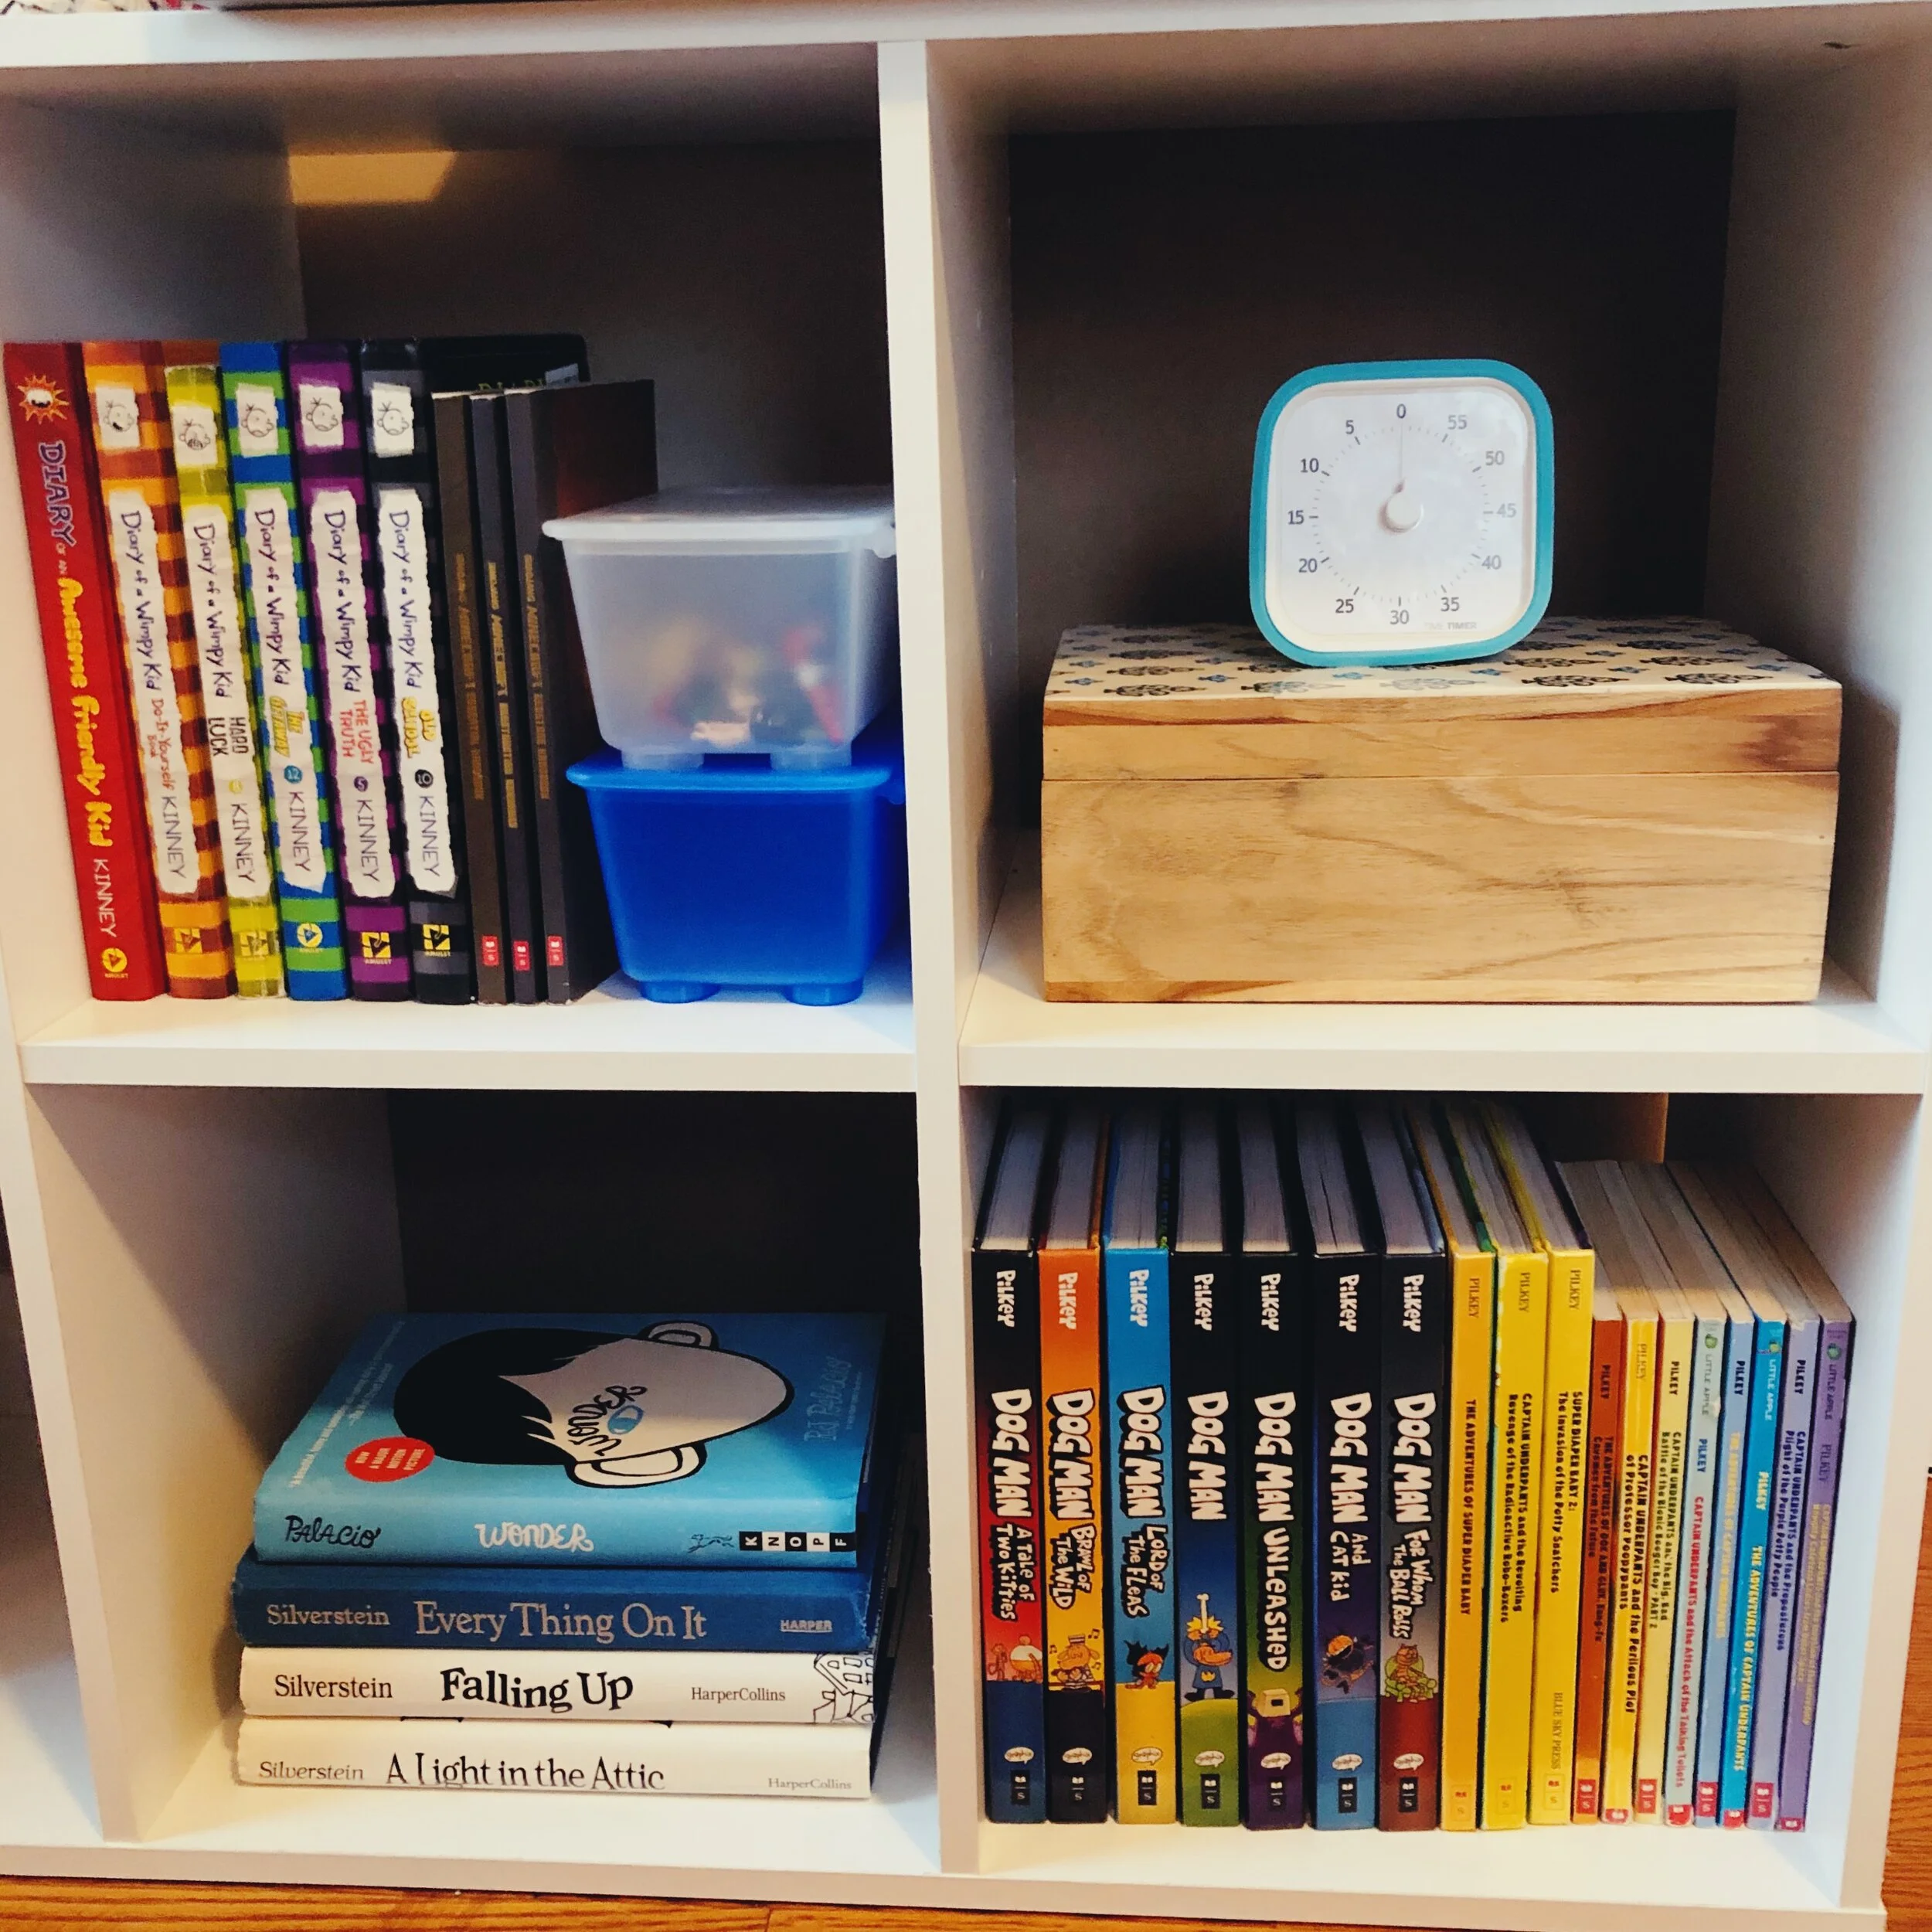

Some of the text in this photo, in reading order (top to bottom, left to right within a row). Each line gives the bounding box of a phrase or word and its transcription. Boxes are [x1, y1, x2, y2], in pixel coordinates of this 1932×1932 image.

[1345, 420, 1355, 434] 5
[1396, 403, 1406, 419] 0
[1447, 415, 1468, 430] 55
[1300, 458, 1319, 473] 10
[1485, 451, 1505, 465] 50
[39, 440, 77, 547] DIARY
[1287, 510, 1304, 525] 15
[1496, 503, 1517, 518] 45
[1298, 558, 1318, 573] 20
[1481, 555, 1502, 570] 40
[195, 524, 233, 697] Diary Wimpy Kid
[254, 509, 292, 685] Diary Wimpy Kid
[324, 510, 362, 692] Diary Wimpy Kid
[389, 510, 423, 689] Diary Wimpy Kid
[1335, 599, 1354, 614] 25
[1390, 610, 1410, 625] 30
[1440, 597, 1460, 611] 35
[1447, 621, 1478, 630] TIMER
[121, 511, 186, 879] Diary Wimpy Kid Do-It-Yourself KINNEY
[287, 711, 305, 734] THE
[419, 709, 437, 742] OLD
[208, 716, 230, 757] LUCK
[229, 716, 249, 754] HARD
[269, 696, 291, 758] GETAWAY
[340, 709, 356, 758] TRUTH
[353, 699, 375, 764] THE UGLY
[401, 696, 420, 759] SCHOOL
[85, 801, 113, 846] Kid
[231, 803, 256, 883] KINNEY
[289, 791, 311, 872] KINNEY
[355, 798, 380, 882] KINNEY
[418, 794, 440, 877] KINNEY
[94, 859, 117, 938] KINNEY
[1569, 1270, 1583, 1498] PILKEY SUPER DIAPER BABY
[1600, 1364, 1612, 1400] PILKEY
[1733, 1360, 1745, 1395] PILKEY
[991, 1389, 1032, 1453] DOG
[1052, 1389, 1094, 1454] DOG
[1123, 1387, 1165, 1451] DOG
[1253, 1392, 1296, 1456] DOG
[1330, 1393, 1372, 1457] DOG
[1460, 1277, 1480, 1615] PILKEY THE ADVENTURES OF SUPER DIAPER BABY
[1512, 1271, 1532, 1612] PILKEY CAPTAIN UNDERPANTS and the Revolting
[1666, 1361, 1682, 1539] PILKEY CAPTAIN UNDERPANTS
[1787, 1359, 1807, 1539] PILKEY CAPTAIN UNDERPANTS
[1187, 1391, 1229, 1520] DOG MAN
[1393, 1393, 1436, 1523] DOG MAN
[993, 1458, 1032, 1518] MAN
[1053, 1459, 1094, 1519] MAN
[1124, 1458, 1164, 1517] MAN
[1255, 1462, 1294, 1522] MAN
[1330, 1464, 1369, 1523] MAN
[1500, 1394, 1518, 1623] Revenge Radioactive Robo-Boxers
[1550, 1392, 1569, 1594] The Invasion Potty Snatchers
[1330, 1530, 1349, 1567] CAT
[1619, 1471, 1635, 1610] Professor Poopypants
[1687, 1438, 1708, 1606] PILKEY CAPTAIN UNDERPANTS
[1627, 1454, 1648, 1686] CAPTAIN UNDERPANTS and the Perilous
[1733, 1359, 1777, 1771] LITTLE THE ADVENTURES CAPTAIN UNDERPANTS
[266, 1600, 833, 1645] Silverstein Every Thing On It HARPER
[274, 1667, 786, 1714] Silverstein Falling Up HarperCollins
[1551, 1692, 1563, 1769] BLUE SKY PRESS
[259, 1761, 365, 1781] Silverstein
[386, 1751, 407, 1784] A
[498, 1760, 531, 1787] in
[535, 1757, 586, 1788] the
[591, 1756, 666, 1791] Attic
[767, 1777, 852, 1791] HarperCollins
